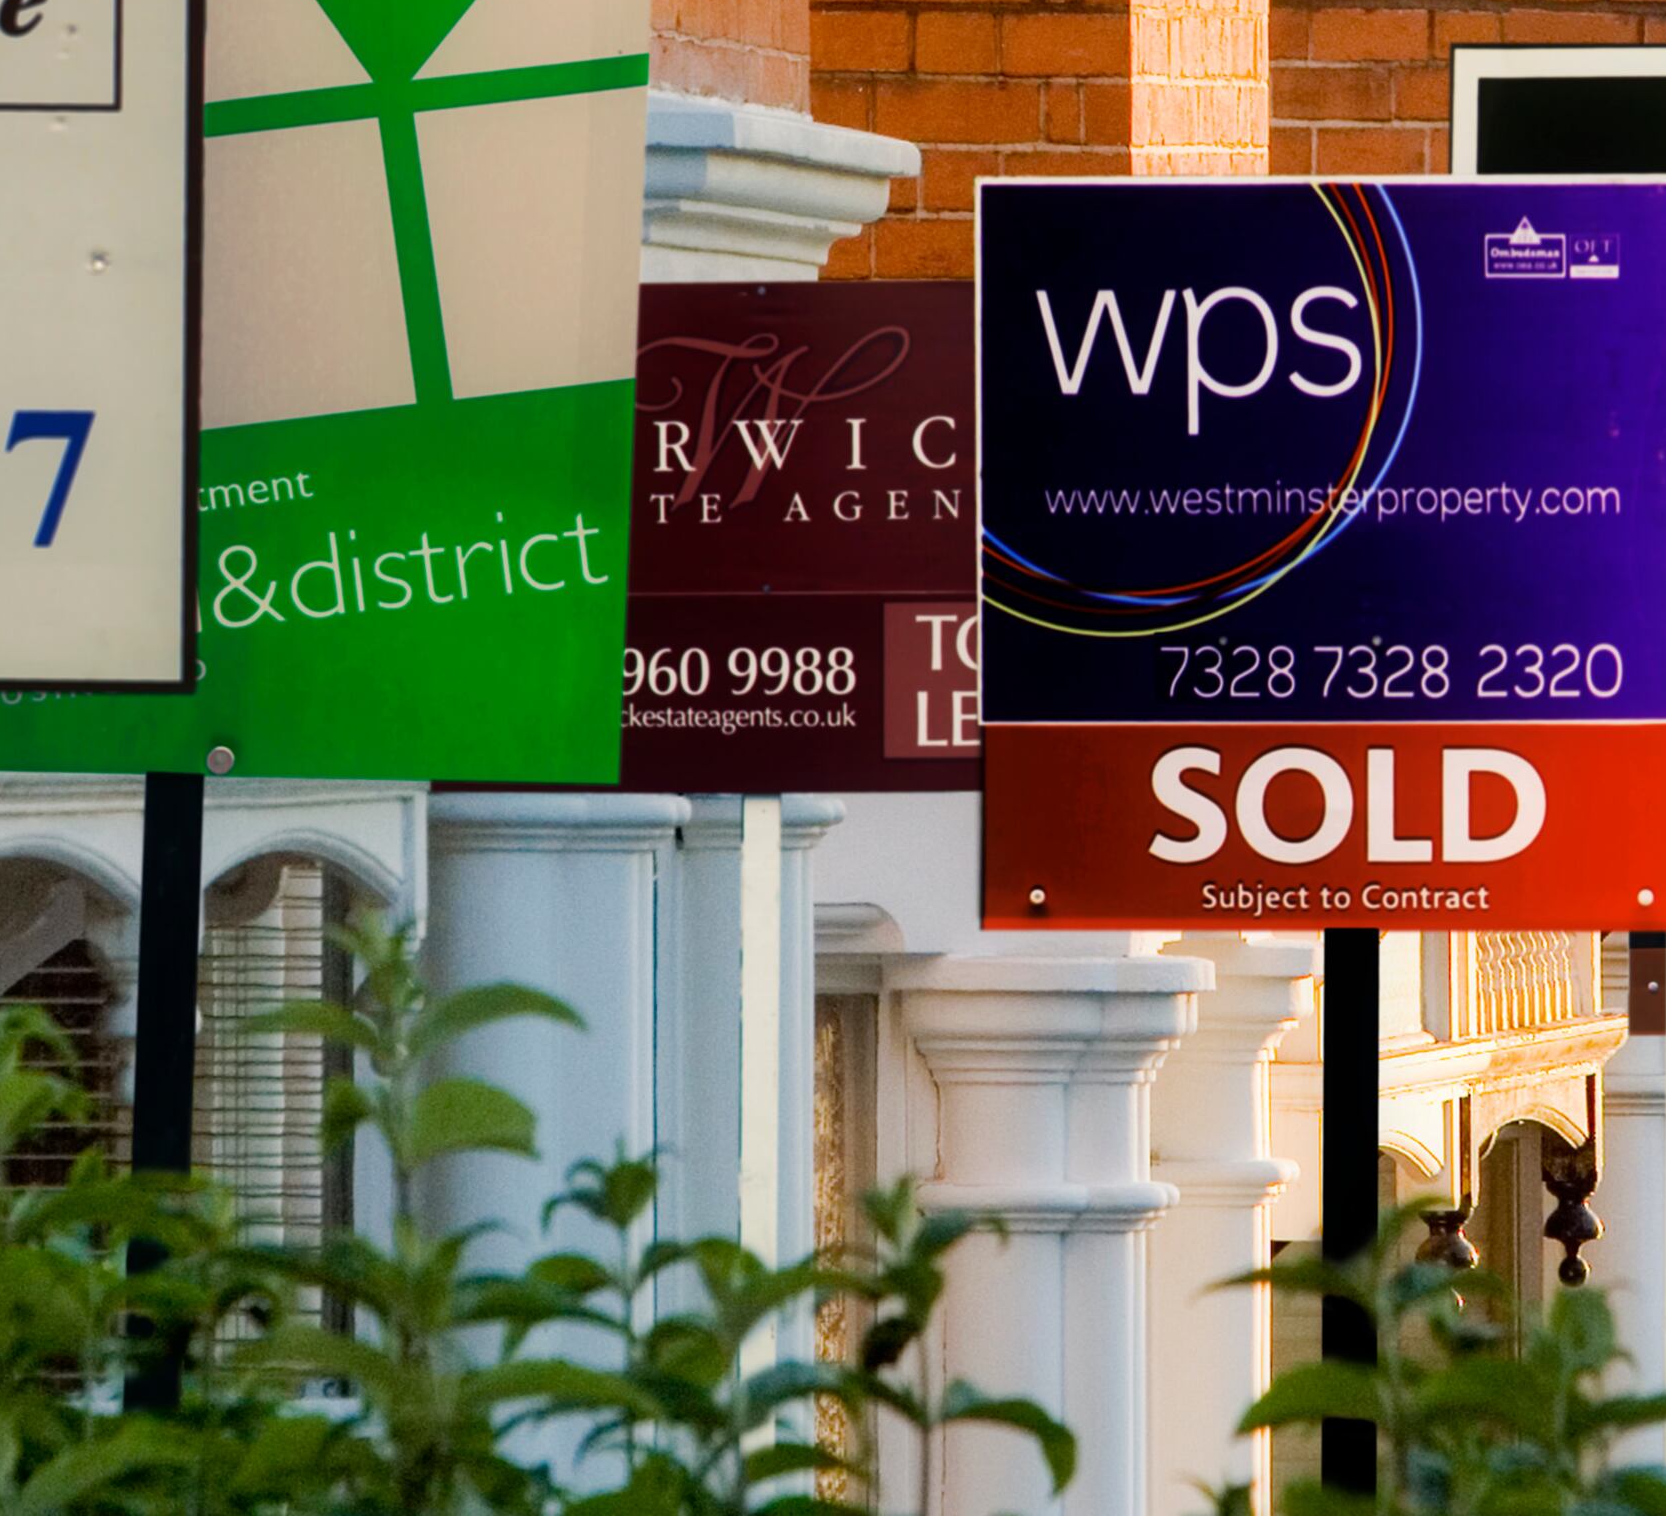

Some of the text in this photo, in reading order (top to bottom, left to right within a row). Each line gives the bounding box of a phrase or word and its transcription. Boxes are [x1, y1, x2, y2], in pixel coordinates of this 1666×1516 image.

[1036, 285, 1364, 435] wps
[652, 416, 957, 473] RWIC
[650, 489, 962, 525] TE AGEN
[1044, 481, 1621, 522] www.westminsterproperty.com
[622, 647, 857, 696] 960 9988
[1159, 643, 1623, 699] 7328 7328 2320
[916, 690, 981, 747] LE
[1148, 746, 1547, 865] SOLD
[1201, 885, 1490, 915] Subject to Contract
